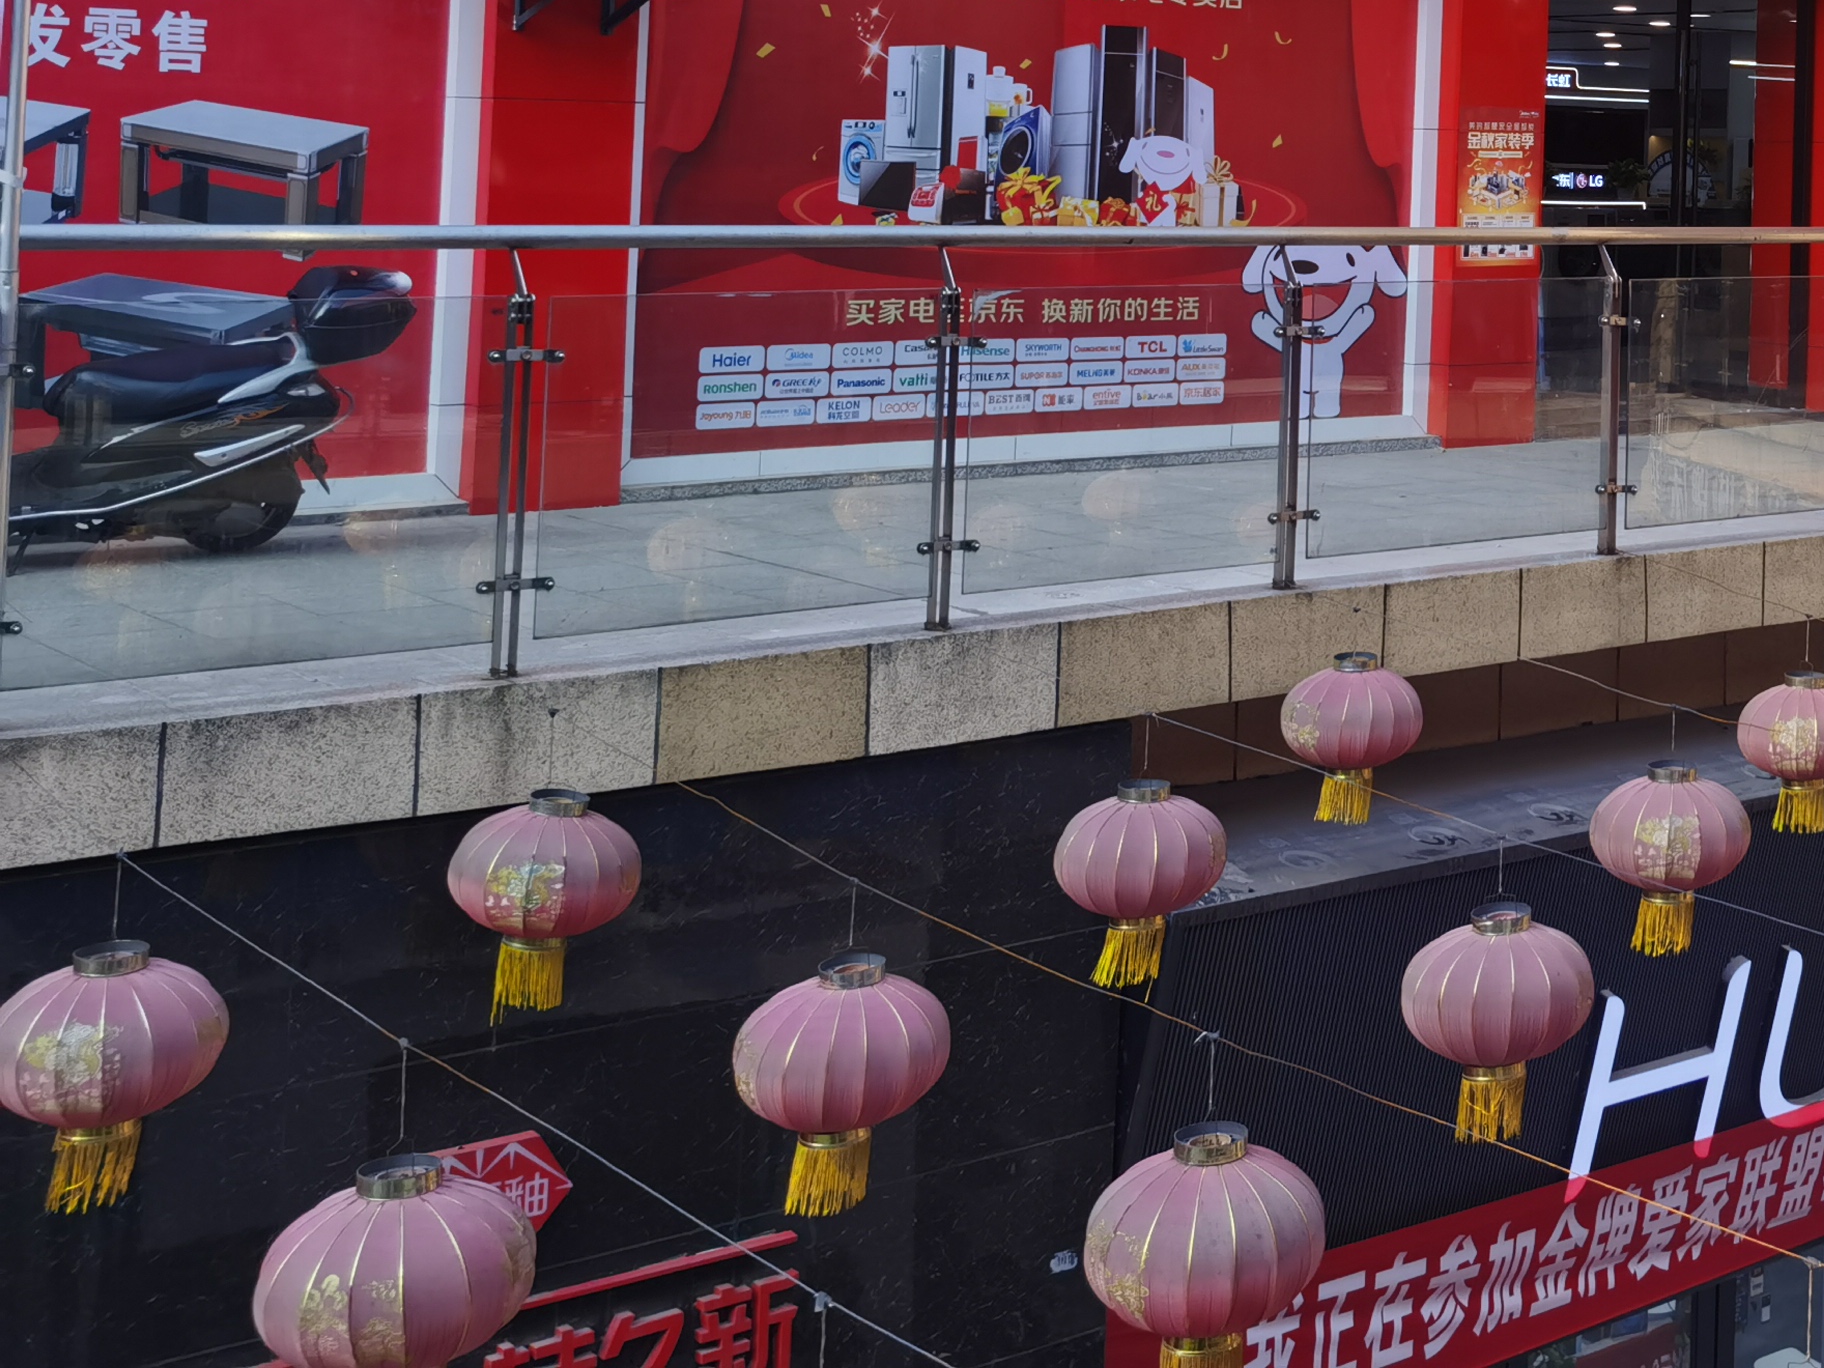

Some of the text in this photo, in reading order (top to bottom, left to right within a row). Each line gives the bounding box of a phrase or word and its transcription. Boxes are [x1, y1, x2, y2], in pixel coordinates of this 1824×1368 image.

[1467, 132, 1535, 150] 金秋家装季
[1588, 174, 1604, 187] LG
[1145, 190, 1162, 212] 礼
[846, 297, 1200, 326] 买家电京东 换新你的生活
[842, 346, 883, 357] COLMO
[1025, 343, 1062, 352] SKYWORTH
[1137, 341, 1168, 353] TCL
[712, 352, 752, 368] Haier
[788, 350, 814, 360] Midea
[1127, 368, 1158, 376] KONKA
[1181, 363, 1200, 371] AUX
[899, 372, 928, 387] vatti
[959, 372, 994, 382] FOTILE
[995, 371, 1011, 381] 方太
[1020, 371, 1045, 380] SUPOR
[837, 375, 886, 388] Panasonic
[703, 382, 757, 395] Ronshen
[1184, 387, 1221, 398] 京东居家
[1058, 394, 1075, 405] 能率
[1092, 390, 1121, 400] entive
[828, 400, 860, 411] KELON
[879, 400, 921, 414] Leader
[699, 410, 733, 422] Joyoung
[734, 409, 752, 420] 九阳
[827, 411, 860, 421] 科龙空调
